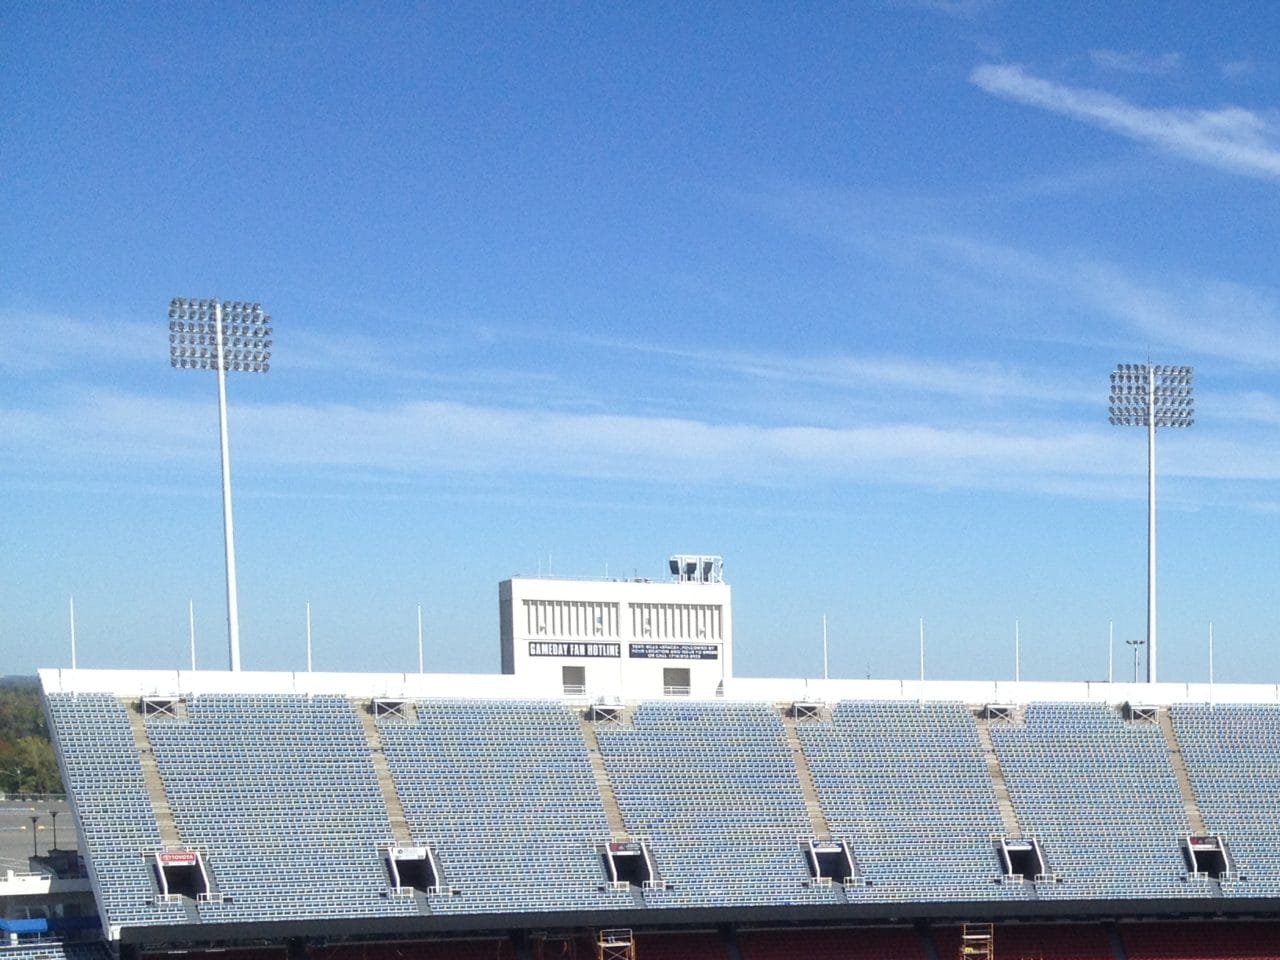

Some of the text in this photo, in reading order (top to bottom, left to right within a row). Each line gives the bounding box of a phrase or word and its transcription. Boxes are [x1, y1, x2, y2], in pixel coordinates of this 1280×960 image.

[530, 643, 619, 656] GAMEDAY FAN HOTLINE
